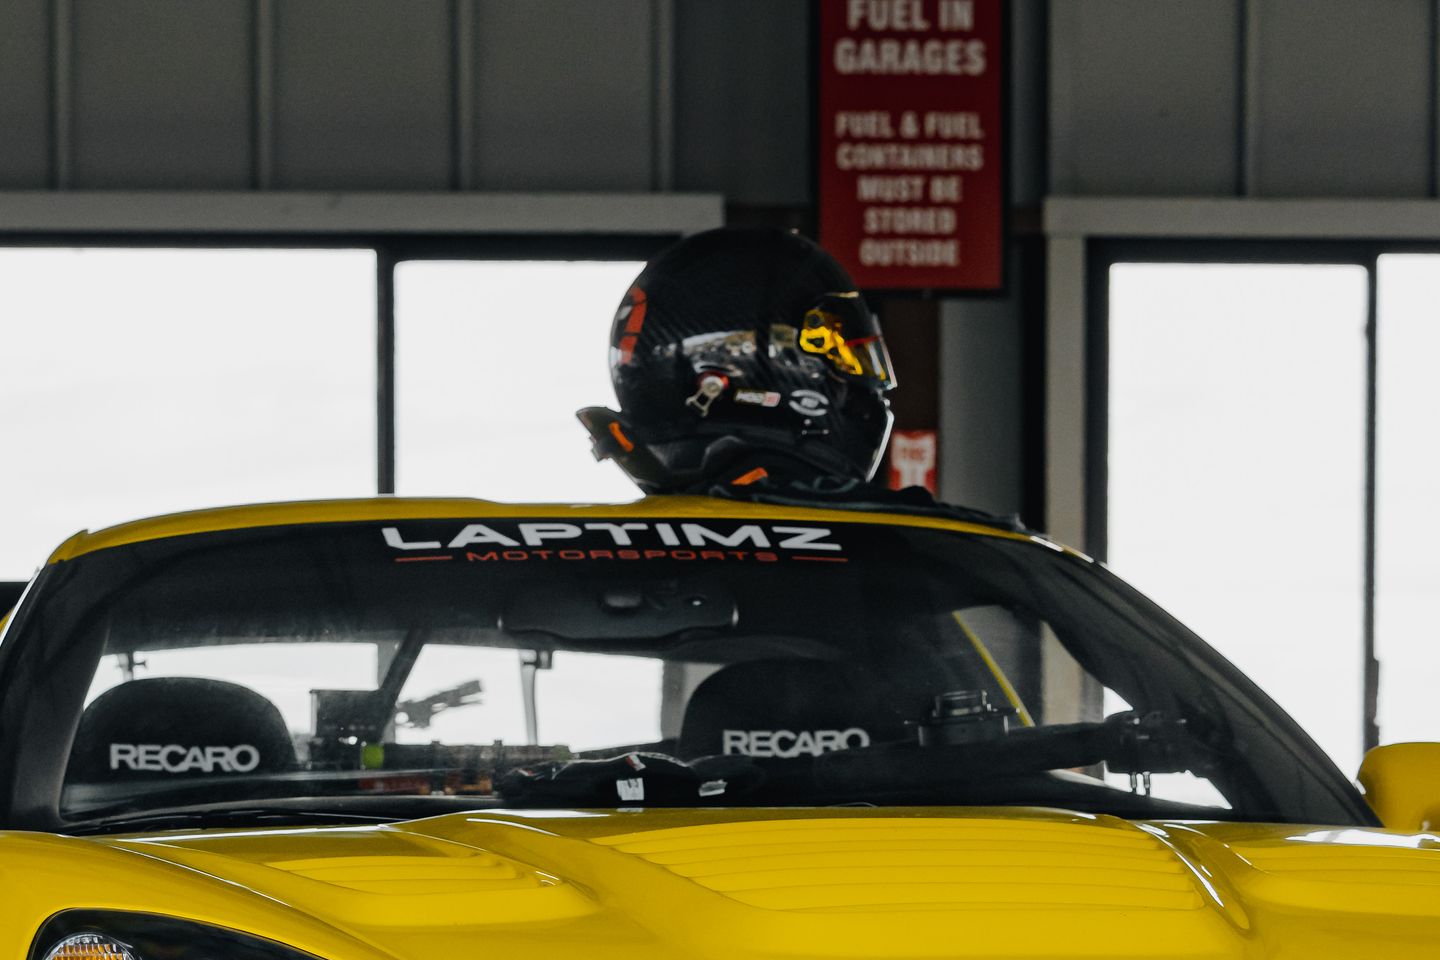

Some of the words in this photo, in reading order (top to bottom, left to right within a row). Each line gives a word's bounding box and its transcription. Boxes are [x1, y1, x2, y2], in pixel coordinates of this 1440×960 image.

[847, 0, 929, 31] FUEL
[938, 0, 974, 31] IN
[834, 39, 986, 75] GARAGES
[835, 110, 893, 138] FUEL
[899, 111, 918, 138] &
[924, 112, 984, 138] FUEL
[835, 143, 984, 170] CONTAINERS
[857, 175, 925, 201] MUST
[929, 176, 962, 202] BE
[864, 207, 956, 234] STORED
[859, 239, 959, 266] OUTSIDE
[381, 522, 842, 550] LAPTIMZ
[465, 550, 778, 561] MOTORSPORTS
[722, 727, 871, 758] RECARO
[109, 743, 259, 772] RECARO
